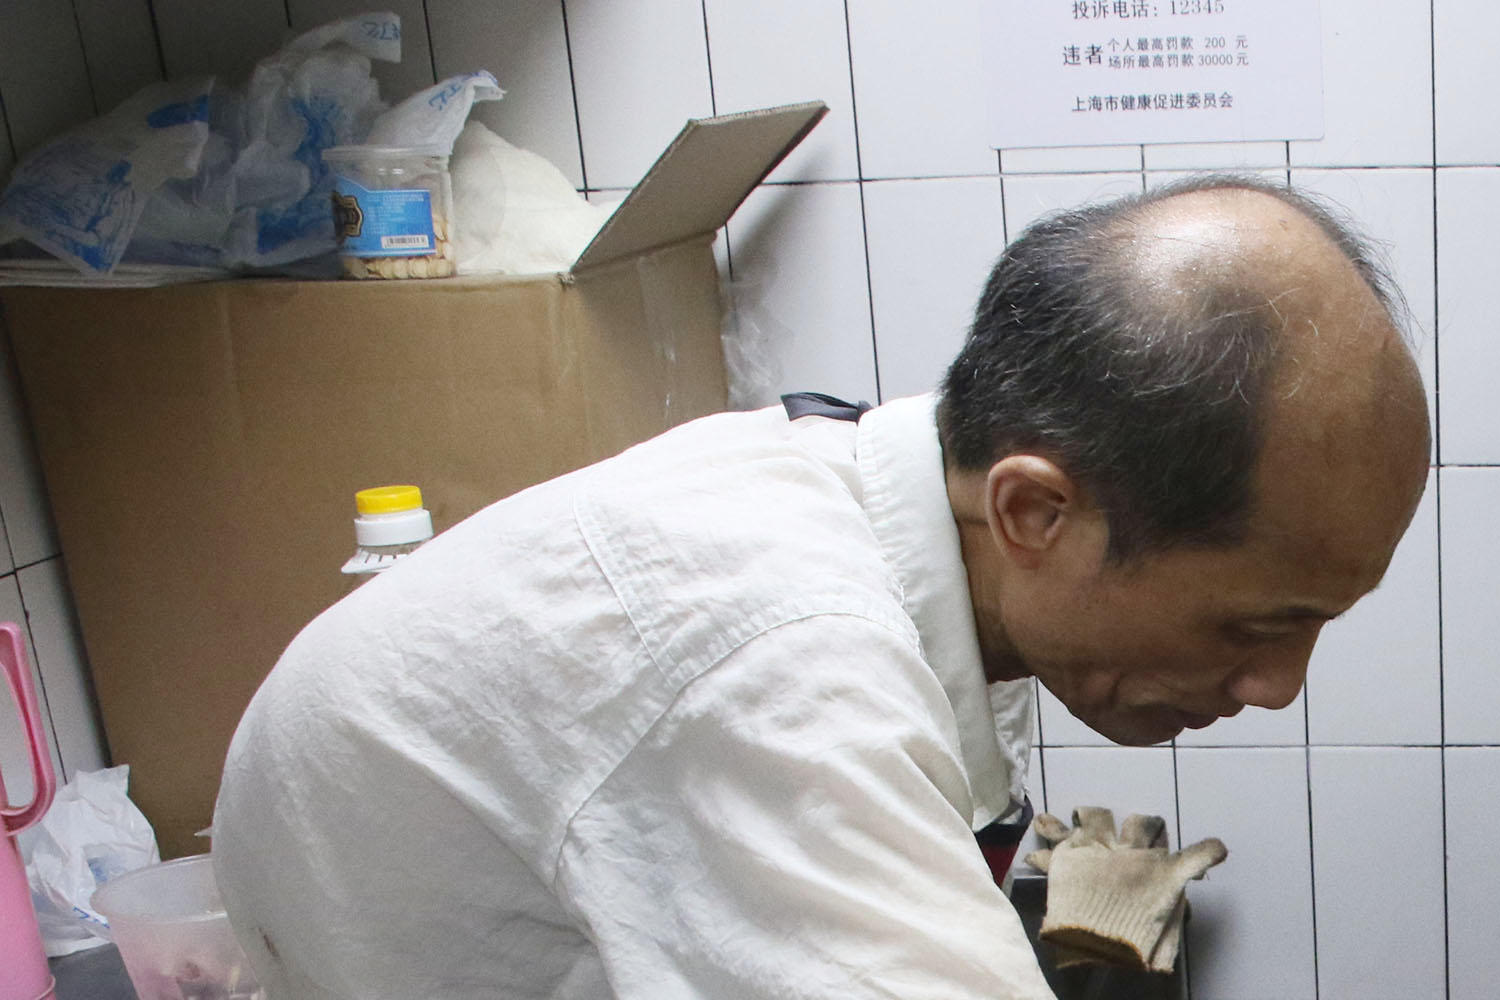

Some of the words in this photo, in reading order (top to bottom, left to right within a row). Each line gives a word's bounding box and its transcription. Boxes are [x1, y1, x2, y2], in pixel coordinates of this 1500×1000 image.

[1063, 44, 1103, 66] 违者
[1072, 91, 1233, 112] 上海市健康促进委员会
